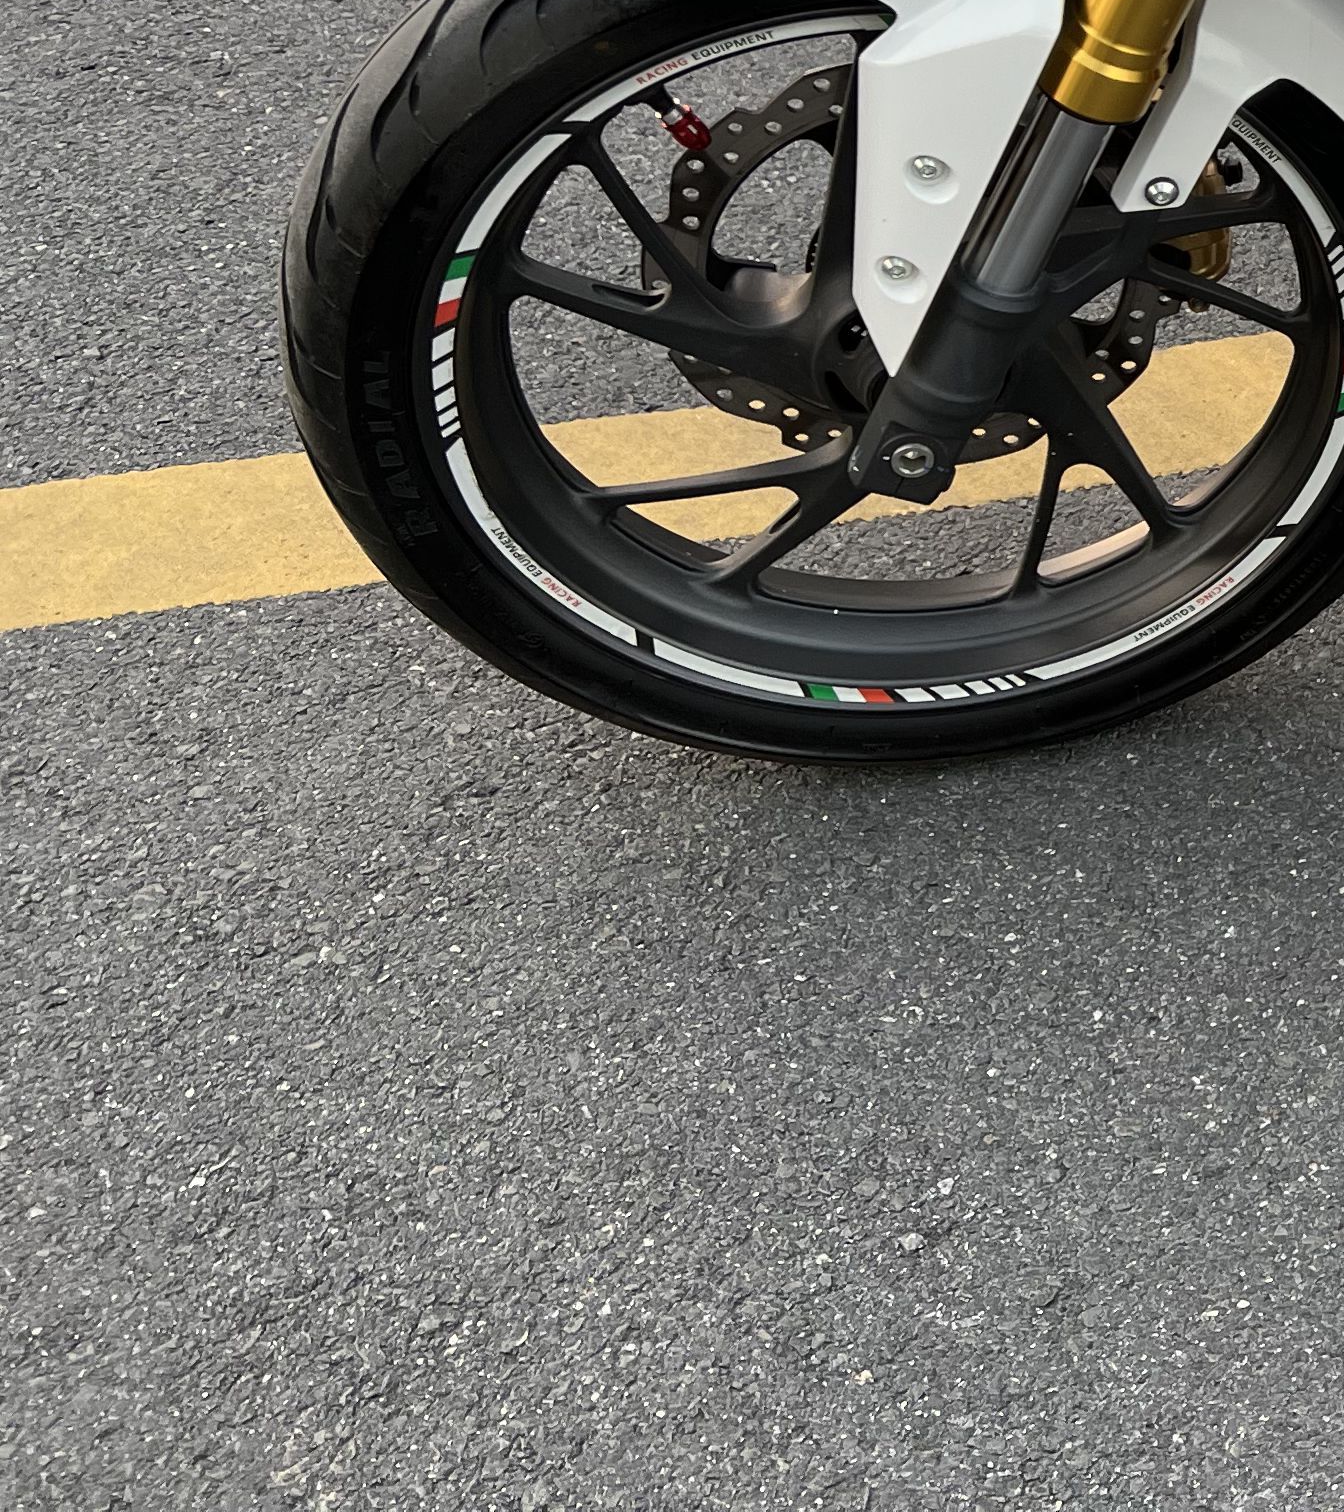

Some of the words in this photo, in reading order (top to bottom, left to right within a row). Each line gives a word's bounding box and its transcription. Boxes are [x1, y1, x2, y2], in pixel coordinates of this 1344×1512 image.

[635, 56, 689, 85] RACING
[691, 30, 775, 61] EQUIPMENT
[1231, 117, 1282, 164] QUIPMENT
[363, 348, 442, 537] RADIAL
[491, 527, 543, 578] EQUIPMENT
[541, 577, 582, 608] RACING
[1196, 575, 1236, 606] RACING
[1133, 604, 1197, 642] EQUIPMENT
